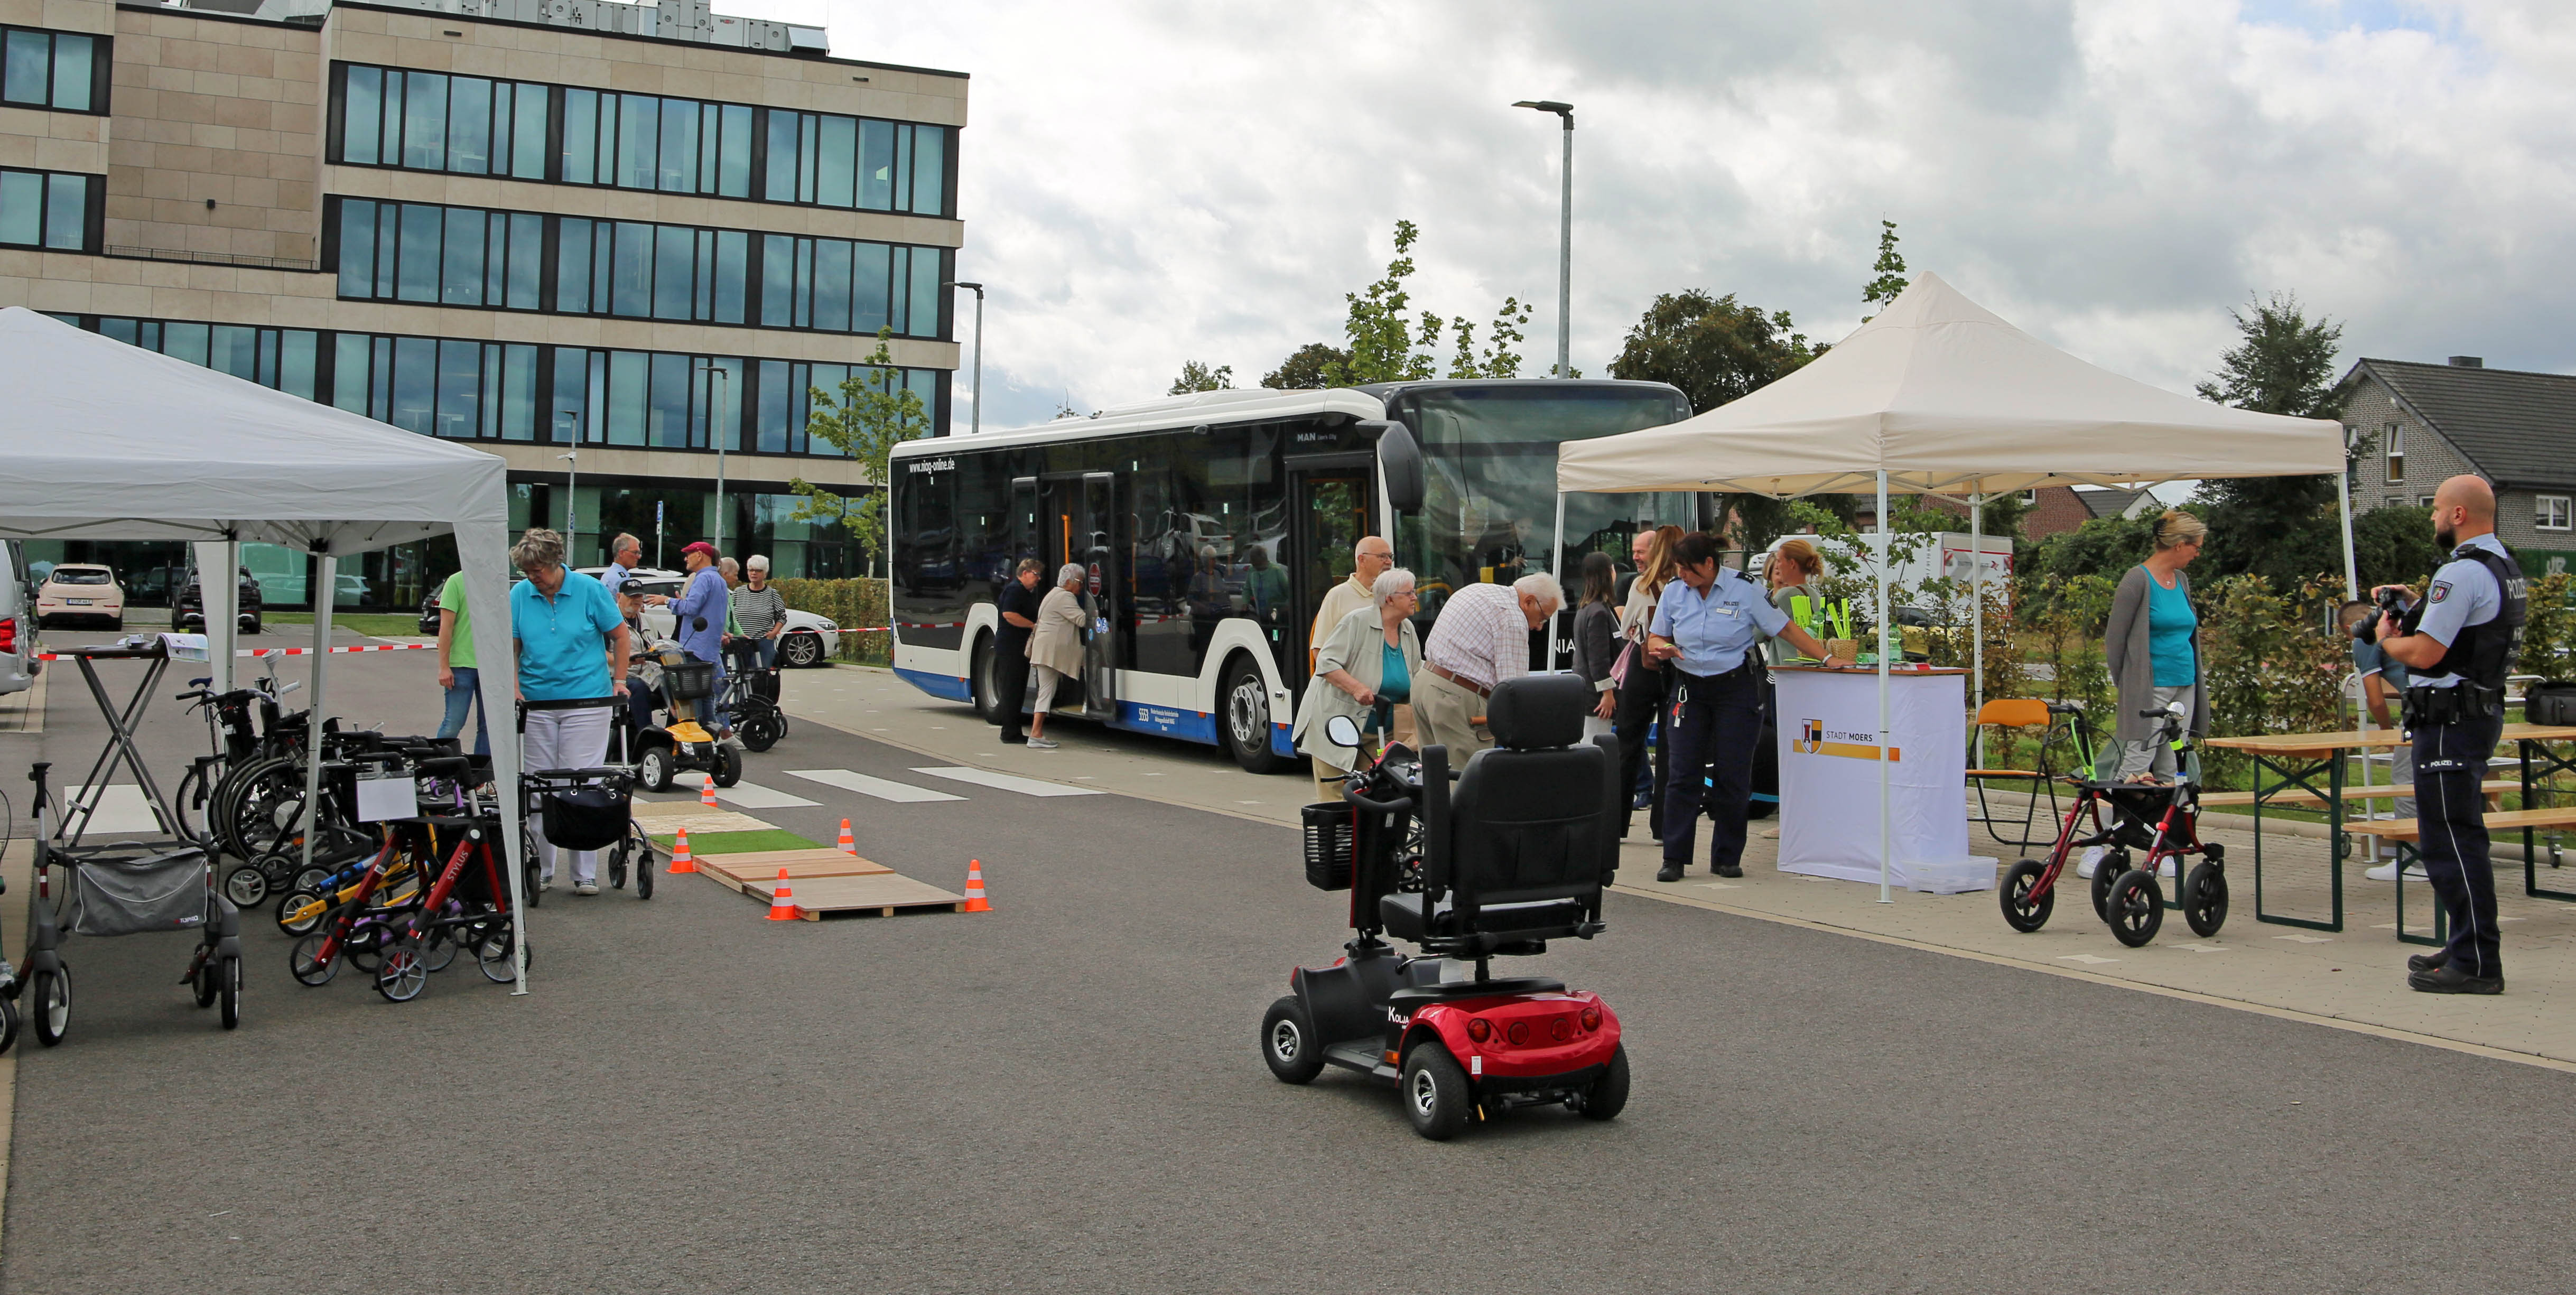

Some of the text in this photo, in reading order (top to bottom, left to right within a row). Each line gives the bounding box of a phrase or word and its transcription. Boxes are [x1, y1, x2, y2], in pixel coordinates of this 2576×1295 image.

[1297, 433, 1316, 442] MAN
[2506, 577, 2526, 600] POLIZE
[1826, 731, 1873, 742] STADT MOERS
[448, 850, 469, 881] STYLUS
[1388, 1006, 1409, 1024] KOLJA
